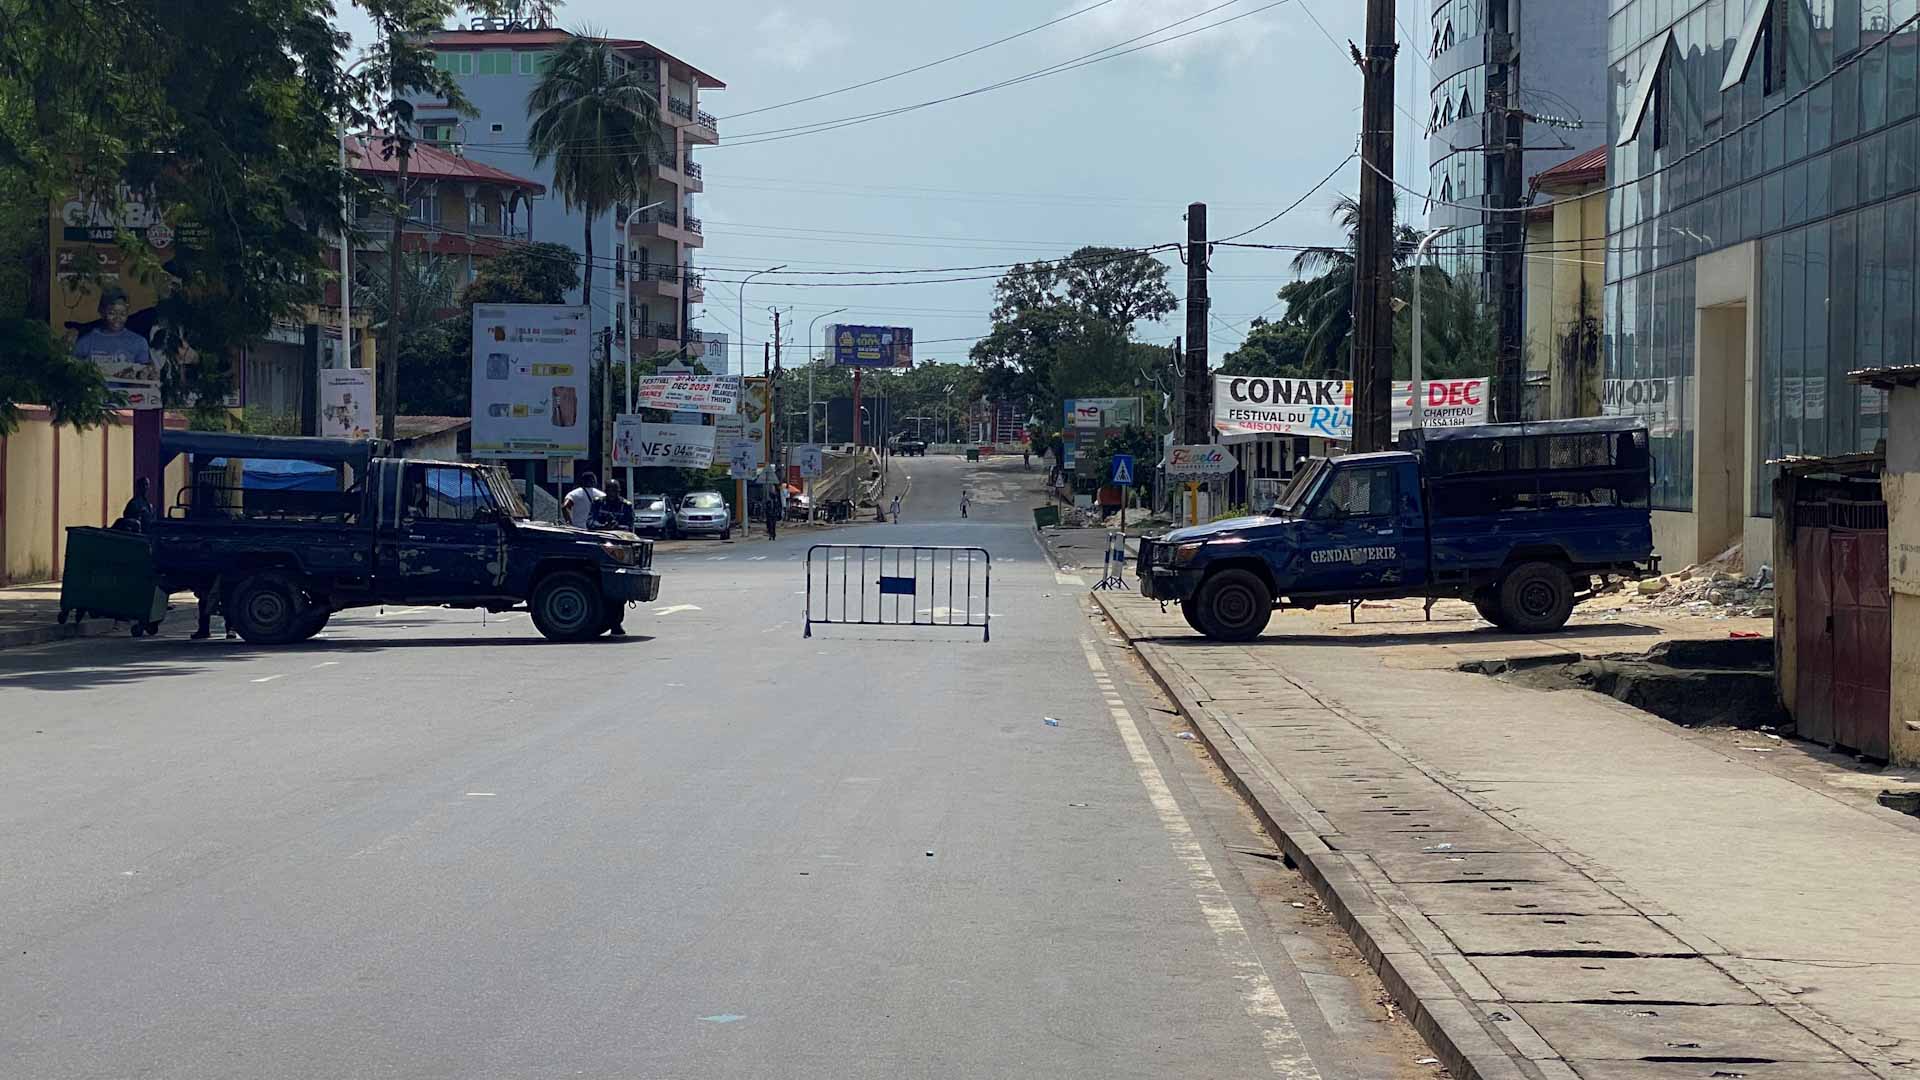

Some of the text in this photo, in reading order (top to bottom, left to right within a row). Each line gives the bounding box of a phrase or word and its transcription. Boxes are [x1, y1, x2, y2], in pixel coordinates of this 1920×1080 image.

[688, 383, 711, 391] 2023
[1428, 380, 1482, 406] DEC
[1229, 409, 1285, 422] FESTIVAL
[1288, 412, 1305, 423] DU
[1423, 407, 1473, 417] CHAPITEAU
[1238, 421, 1292, 432] SAISON 2
